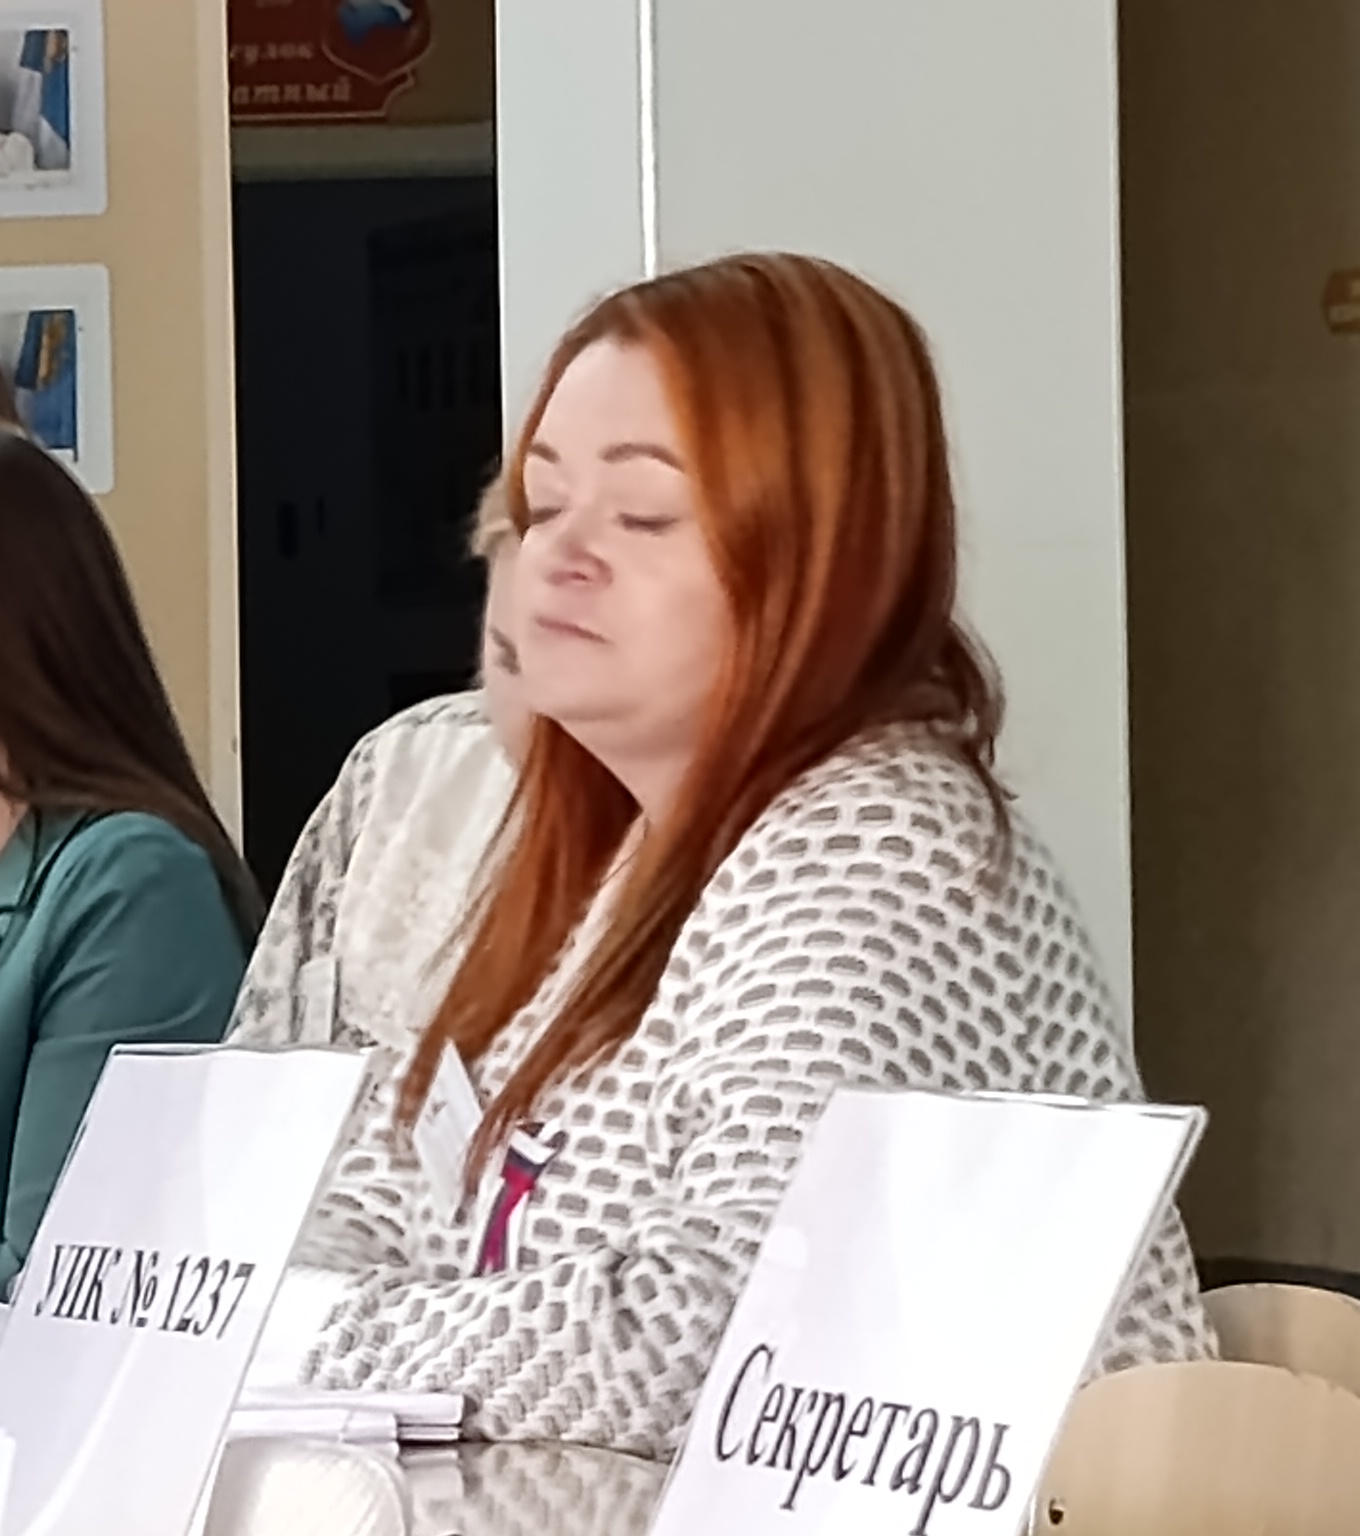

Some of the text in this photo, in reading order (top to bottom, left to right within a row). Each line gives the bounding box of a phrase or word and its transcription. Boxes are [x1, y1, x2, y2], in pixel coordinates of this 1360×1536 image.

[35, 1245, 256, 1340] УИК № 1237
